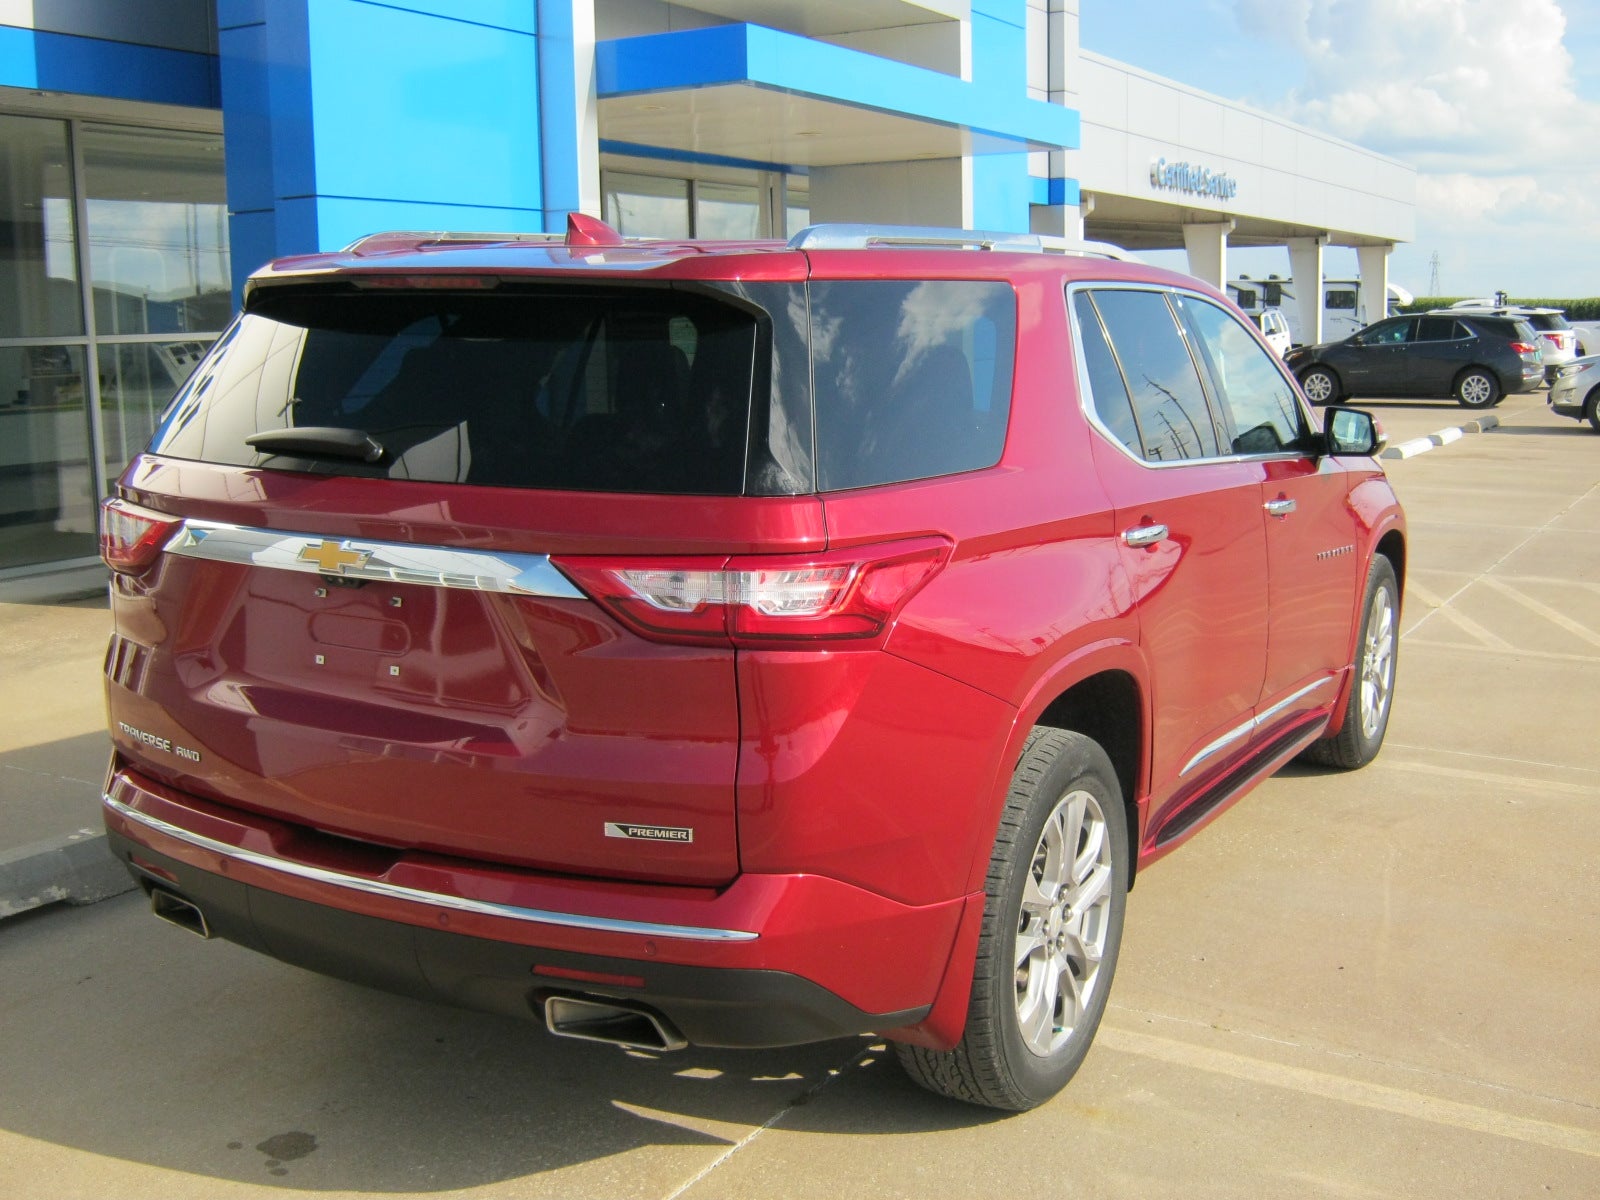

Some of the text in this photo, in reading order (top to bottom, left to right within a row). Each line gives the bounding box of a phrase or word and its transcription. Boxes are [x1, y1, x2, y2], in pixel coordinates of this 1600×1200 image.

[119, 721, 200, 762] TRAVERSE AWD
[628, 827, 687, 839] PREMIER
